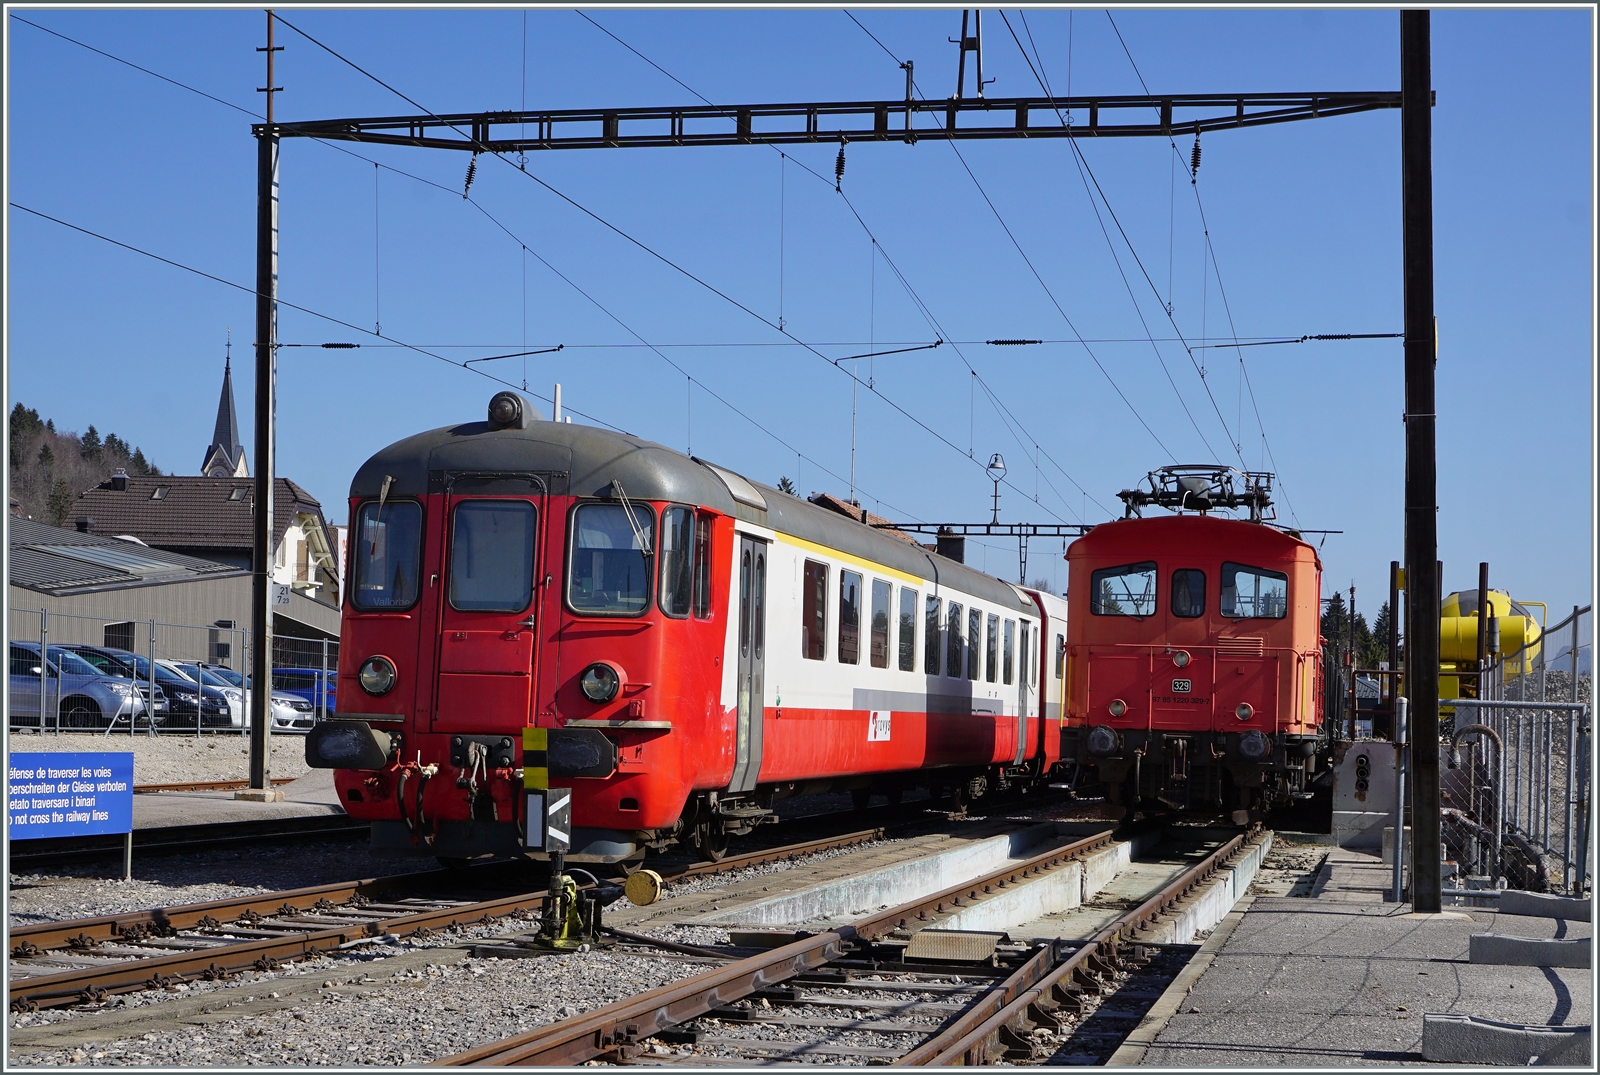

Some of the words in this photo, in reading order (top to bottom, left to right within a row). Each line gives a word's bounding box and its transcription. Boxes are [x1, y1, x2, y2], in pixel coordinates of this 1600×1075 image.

[280, 586, 289, 595] 21
[373, 597, 411, 606] Vallorbe
[1174, 681, 1189, 691] 329
[9, 767, 34, 780] éfense
[36, 767, 46, 779] de
[48, 767, 80, 779] traverser
[81, 766, 92, 778] les
[93, 766, 112, 778] voies
[9, 782, 55, 794] berschreiten
[57, 782, 70, 793] der
[72, 781, 95, 793] Gleise
[97, 781, 127, 792] verboten
[9, 798, 30, 810] etato
[32, 797, 69, 809] traversare
[75, 795, 96, 807] binari
[15, 813, 28, 825] not
[29, 814, 50, 824] cross
[52, 811, 64, 823] the
[66, 810, 91, 824] railway
[92, 809, 109, 821] lines
